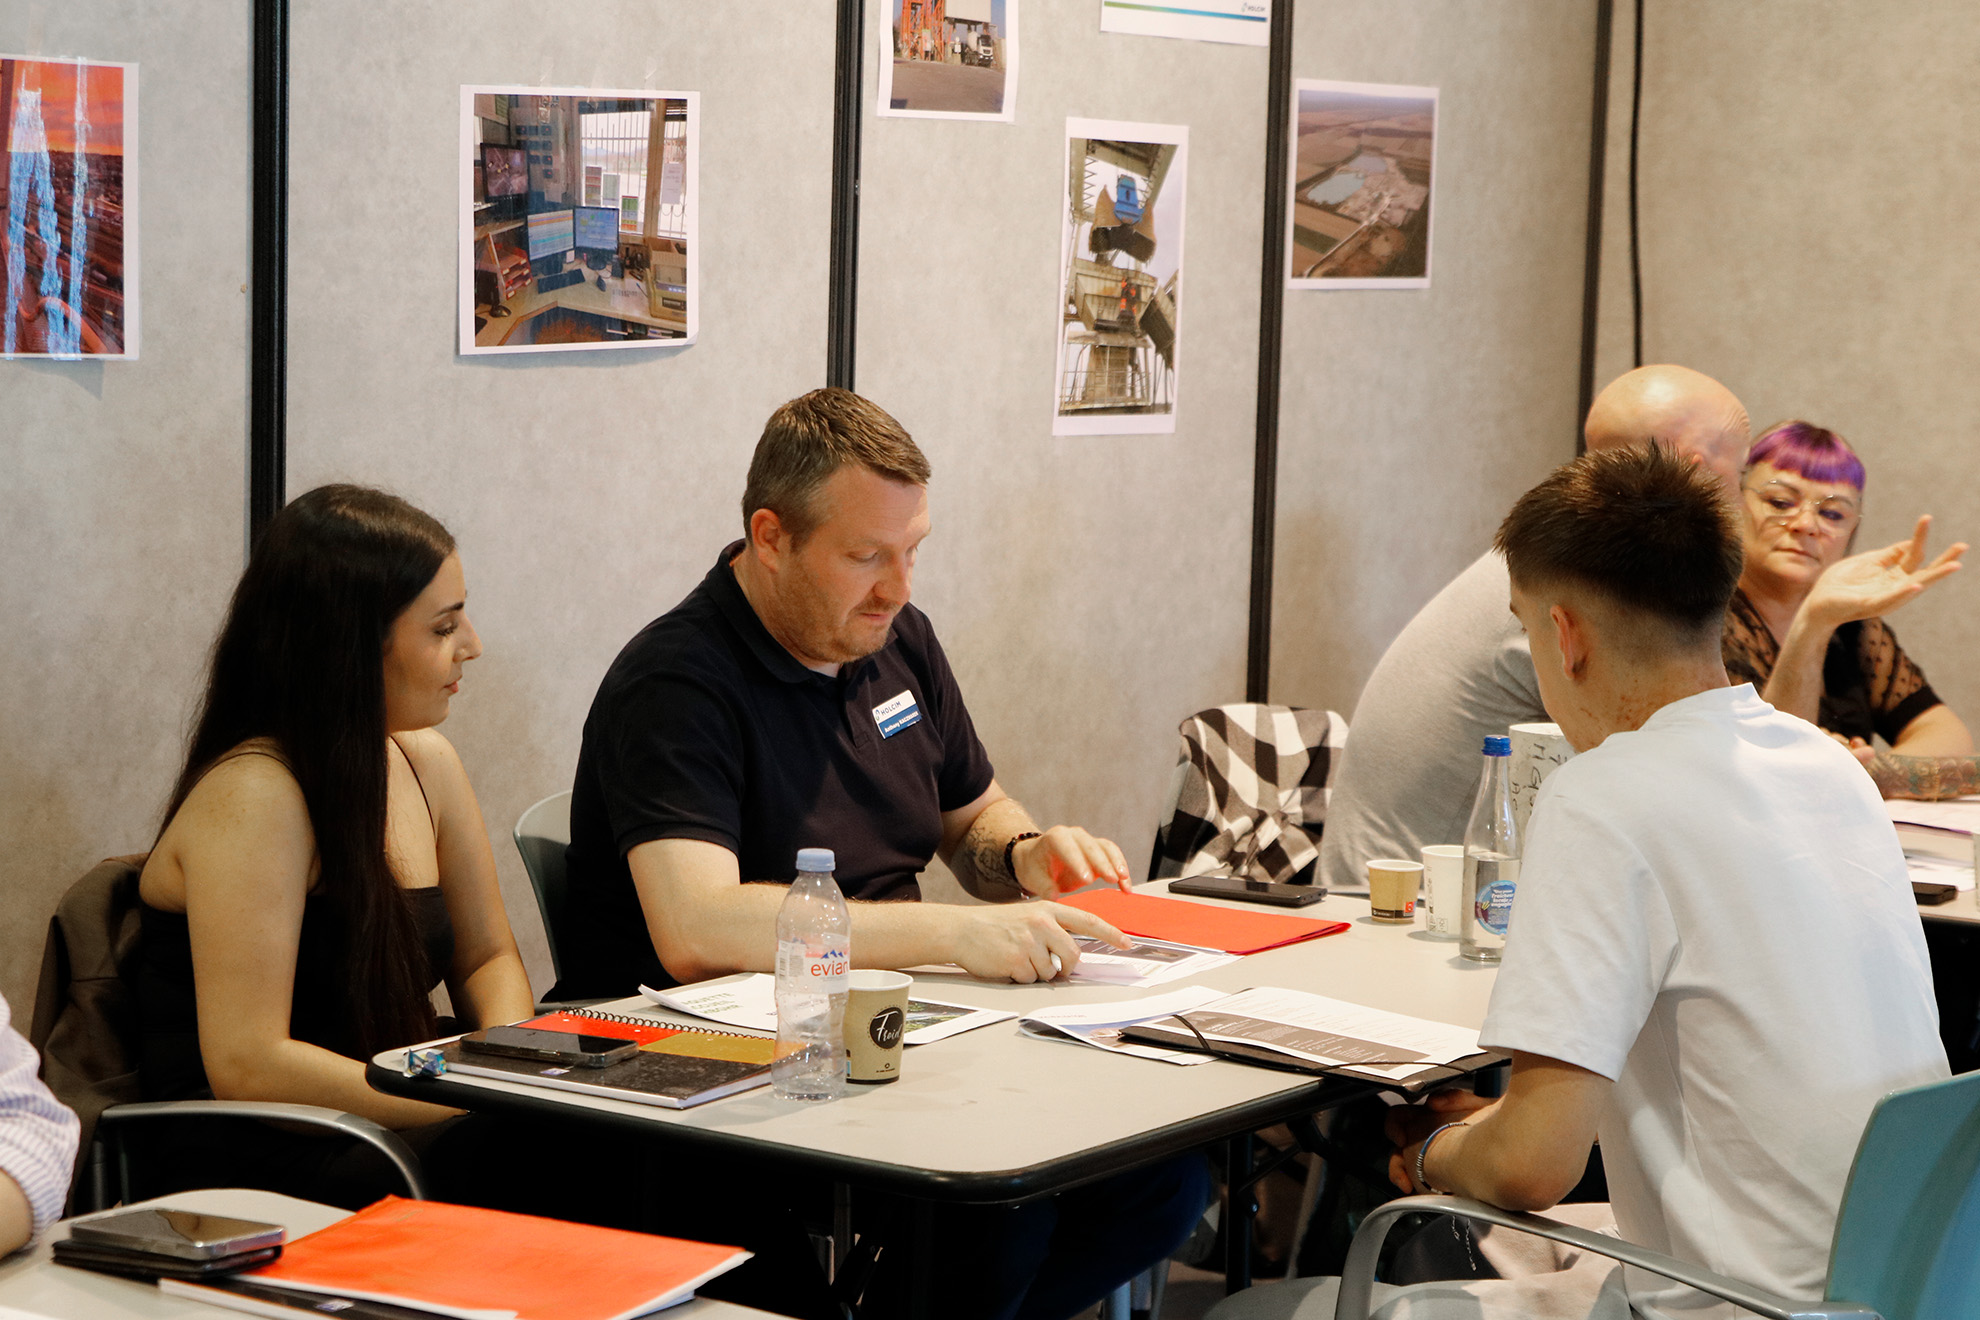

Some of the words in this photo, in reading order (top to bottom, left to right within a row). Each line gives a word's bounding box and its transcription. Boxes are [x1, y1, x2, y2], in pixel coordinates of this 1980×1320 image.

[881, 701, 902, 716] HOLCIM
[811, 960, 848, 977] evian
[873, 1010, 902, 1042] Froid
